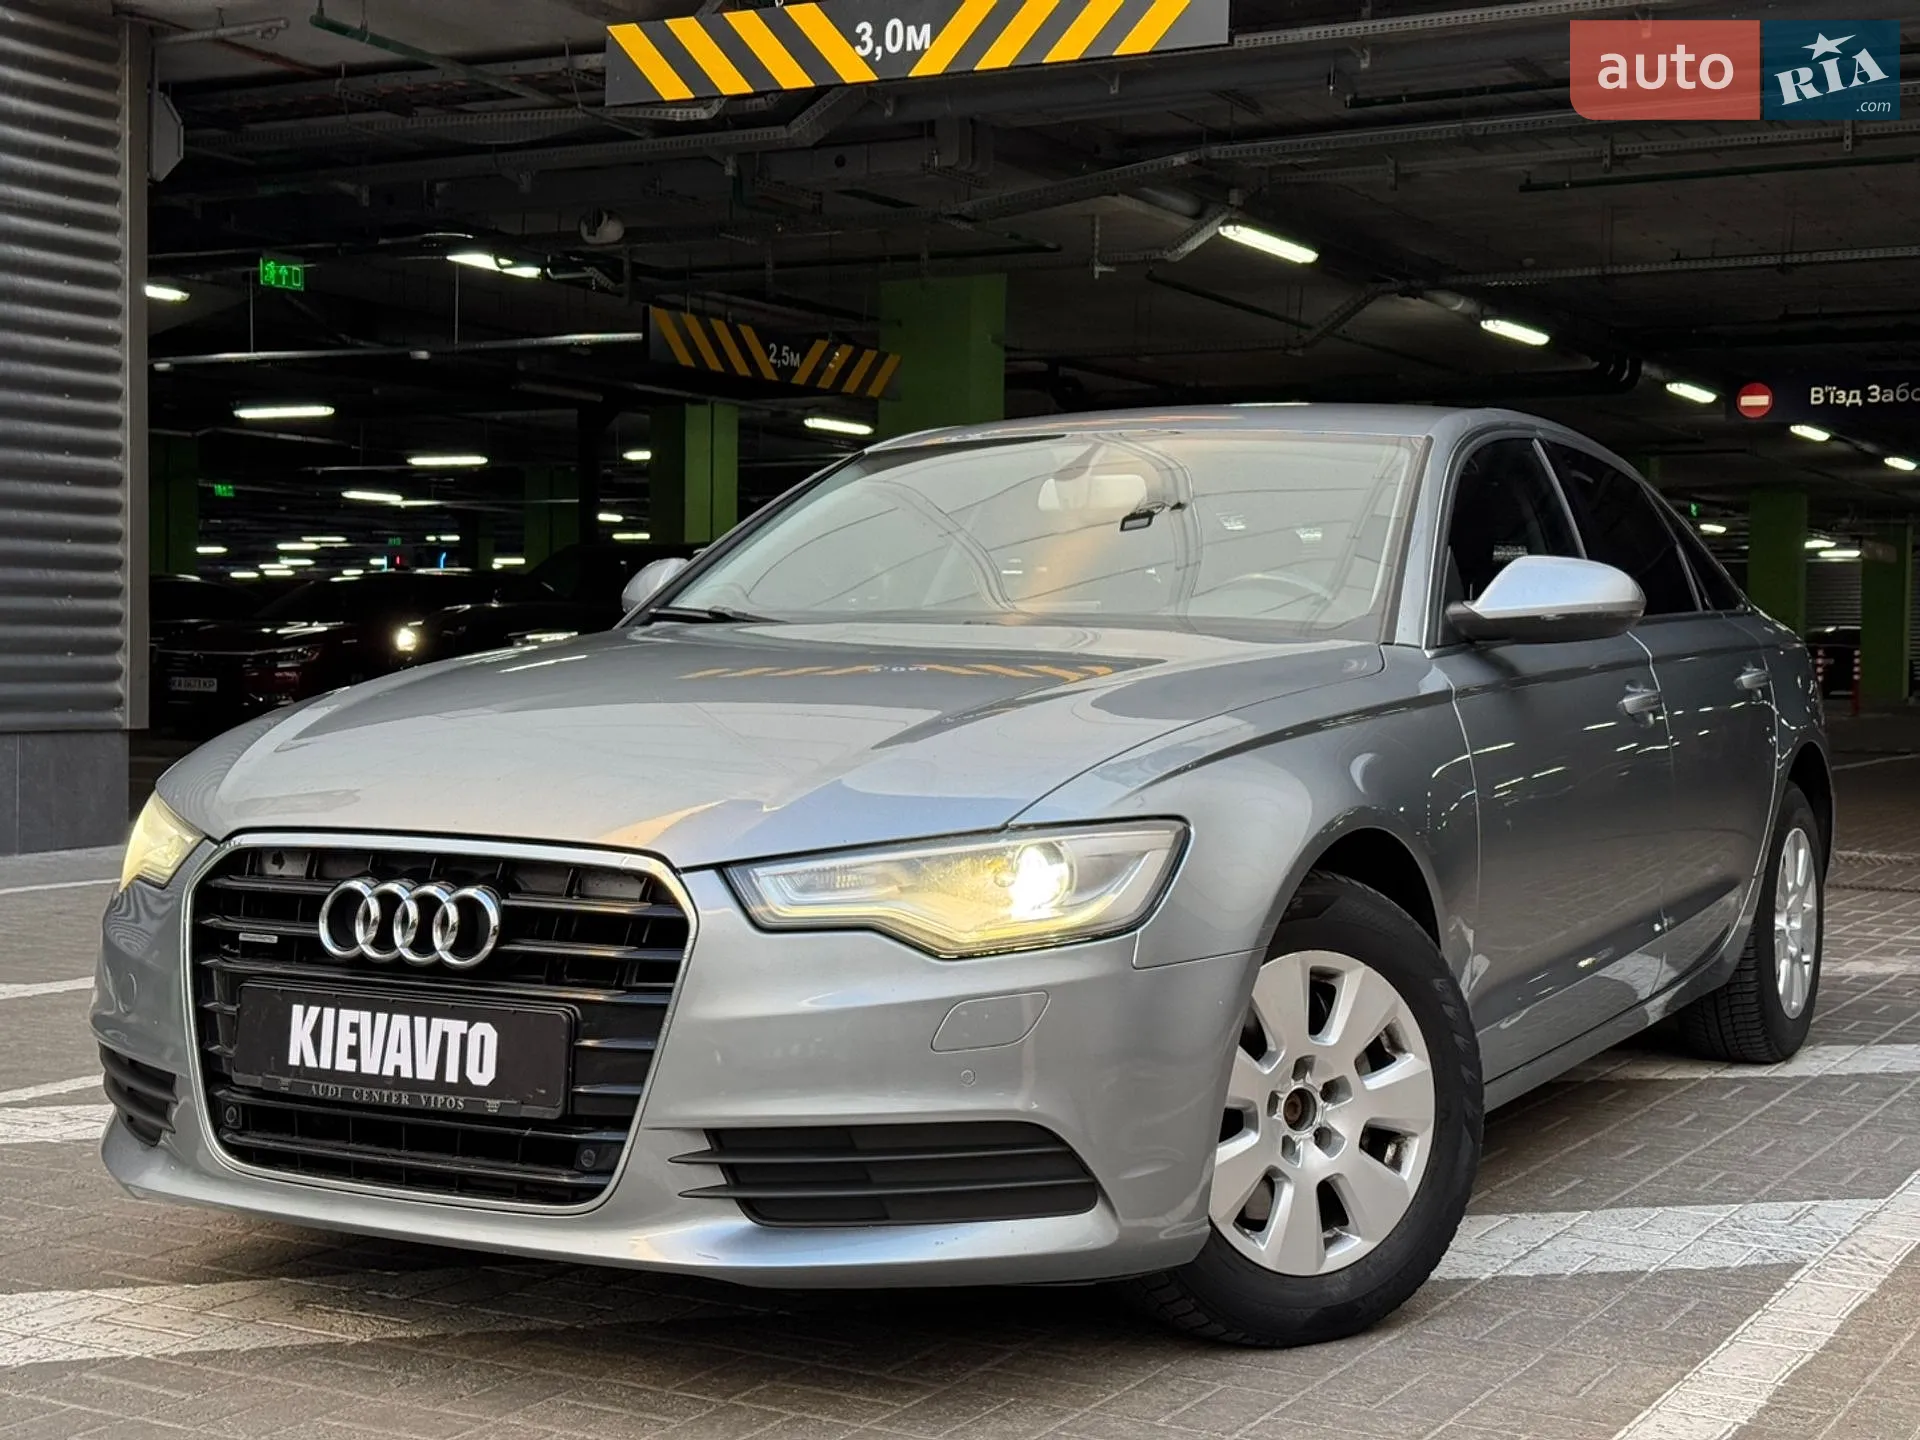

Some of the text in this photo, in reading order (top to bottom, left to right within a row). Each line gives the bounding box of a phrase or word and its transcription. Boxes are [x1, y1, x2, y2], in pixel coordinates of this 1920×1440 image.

[855, 17, 931, 62] 3,0м
[768, 343, 801, 369] 2,5м
[288, 1003, 498, 1087] KIEVAVTO
[310, 1083, 465, 1111] AUDI CENTER VIPOS
